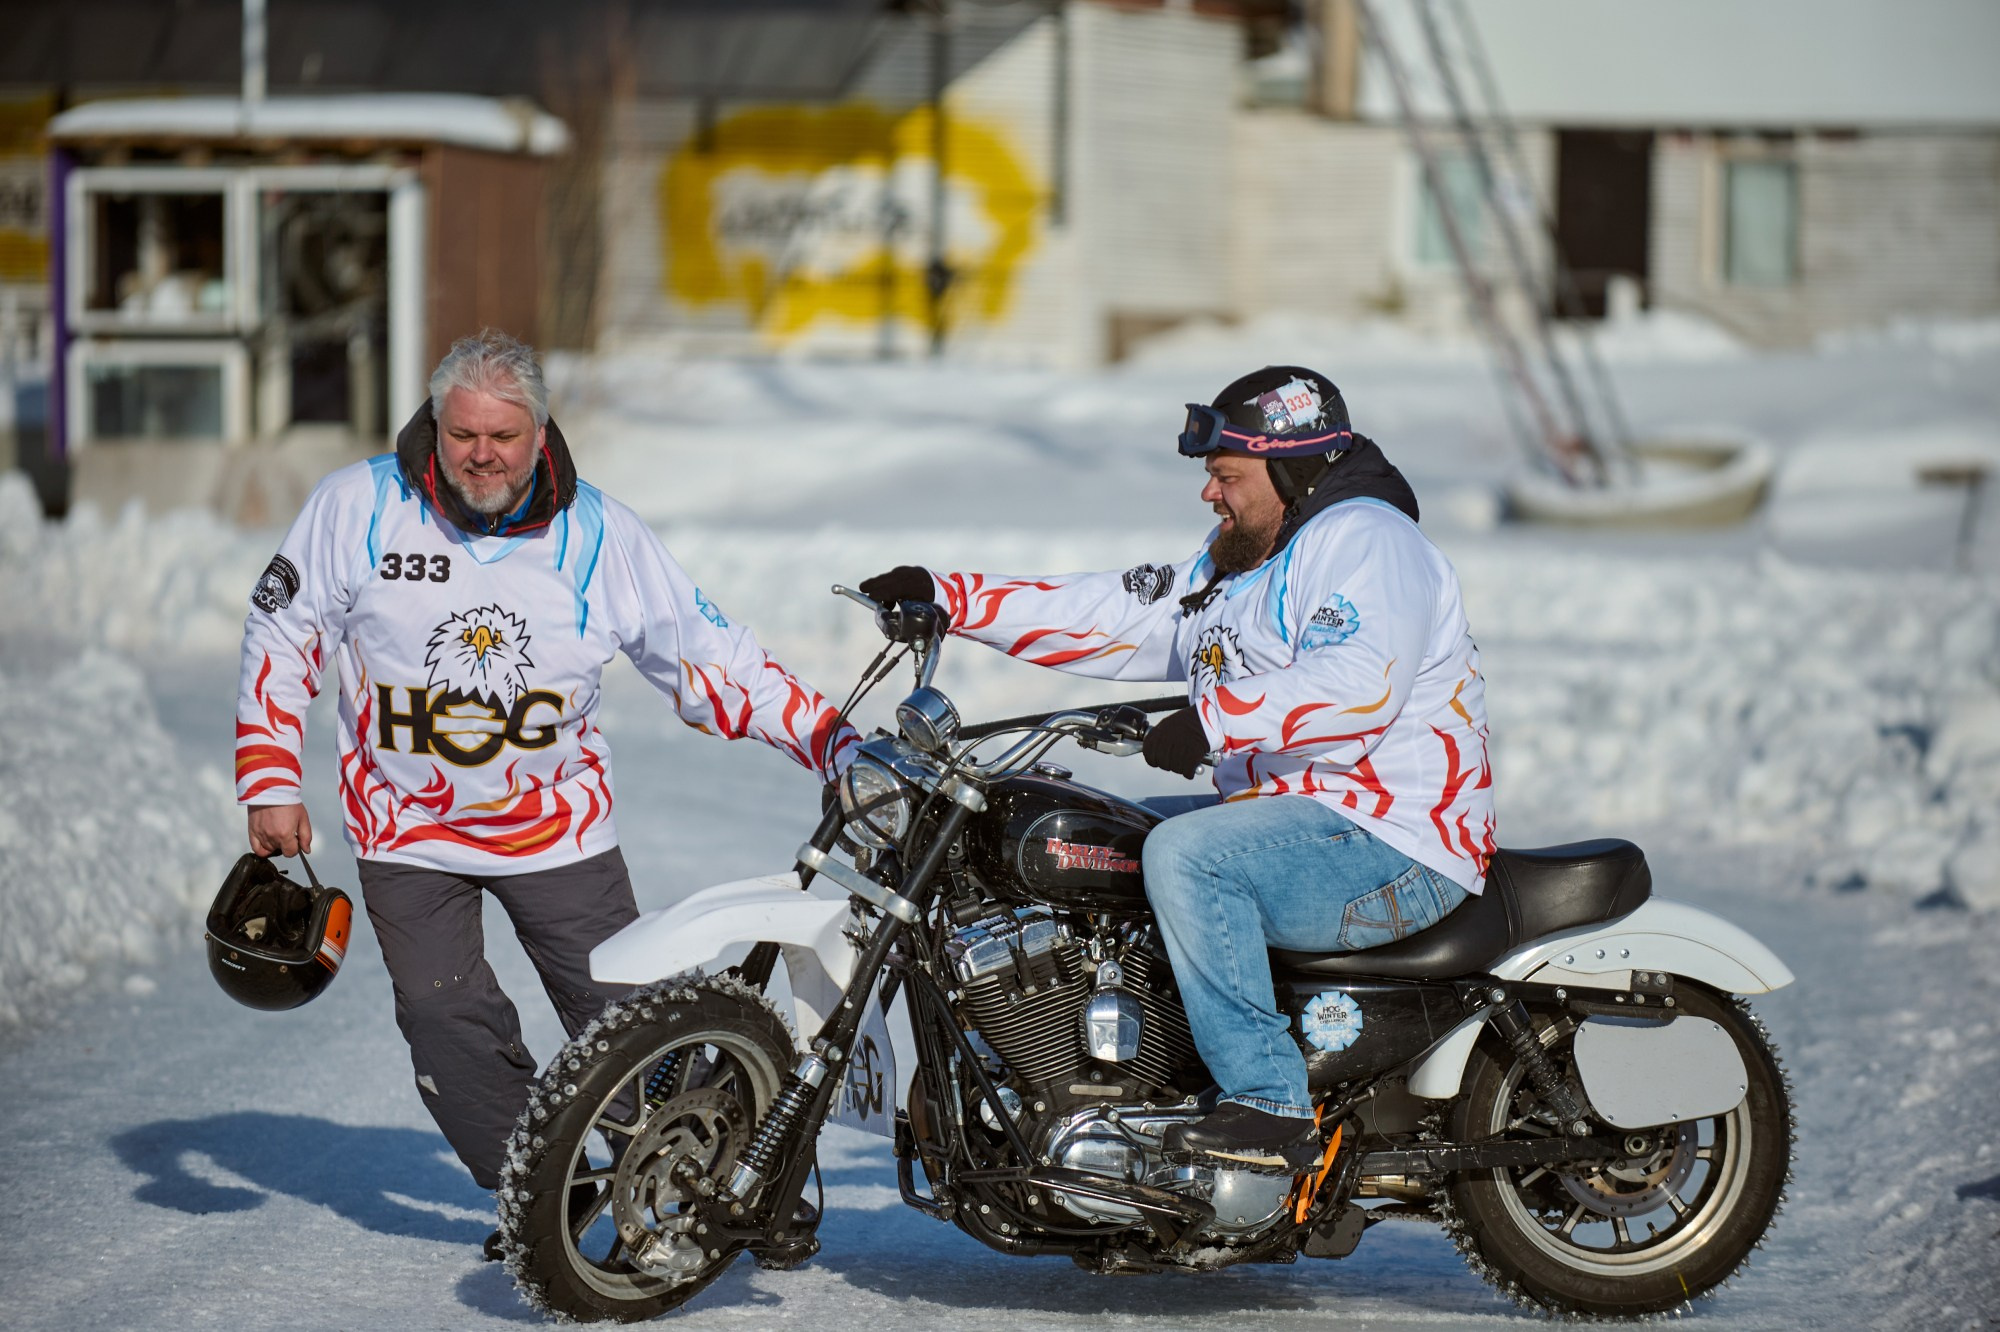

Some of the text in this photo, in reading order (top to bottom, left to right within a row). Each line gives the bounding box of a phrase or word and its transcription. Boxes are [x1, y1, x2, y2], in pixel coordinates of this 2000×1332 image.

[1286, 392, 1312, 412] 333
[380, 552, 451, 583] 333
[1310, 613, 1345, 627] WINTER
[1317, 606, 1340, 618] HOG
[374, 681, 566, 768] HOG
[1056, 854, 1141, 873] DAVIDSON
[1317, 1011, 1347, 1021] WINTER
[1323, 1006, 1340, 1014] HOG
